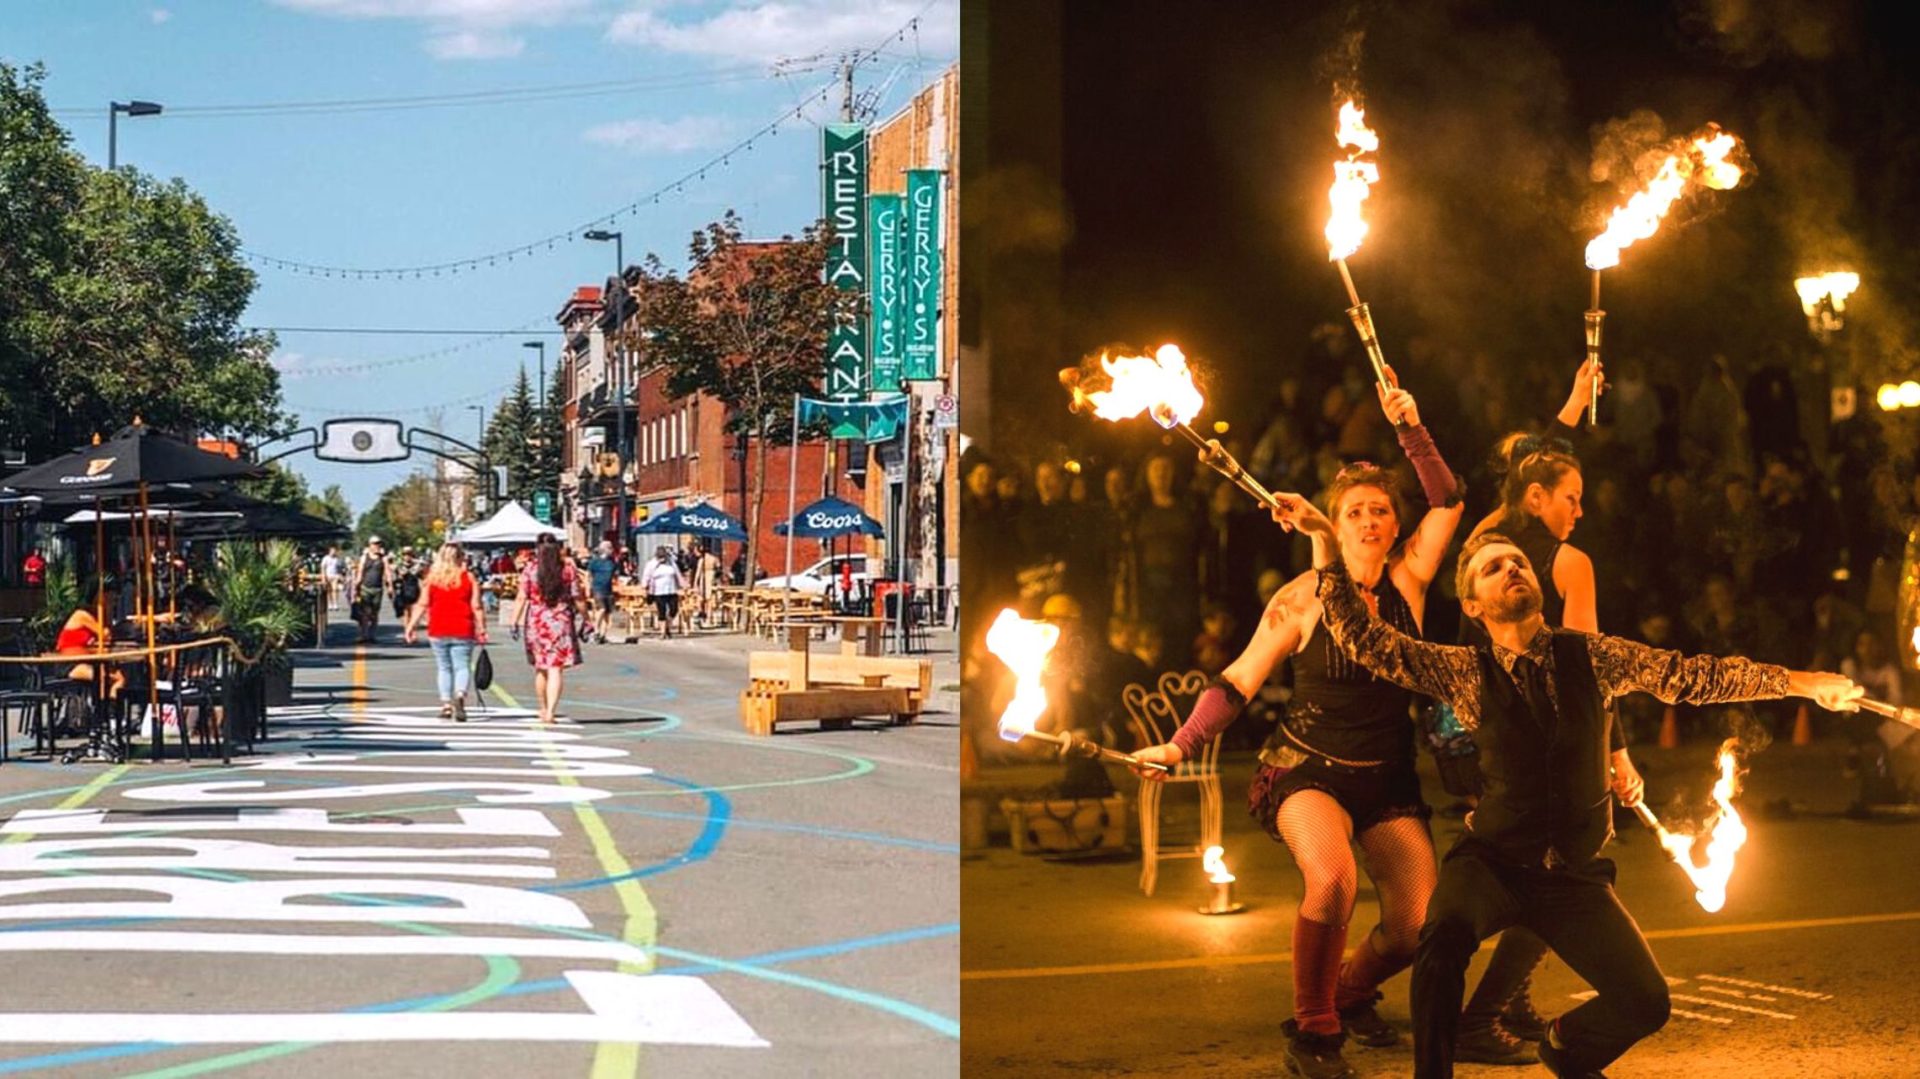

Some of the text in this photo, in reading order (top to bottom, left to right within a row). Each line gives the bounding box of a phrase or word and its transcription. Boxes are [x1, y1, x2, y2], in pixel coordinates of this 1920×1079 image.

[831, 151, 863, 418] RESTARANT
[680, 514, 730, 530] Coors
[806, 512, 863, 529] Coors
